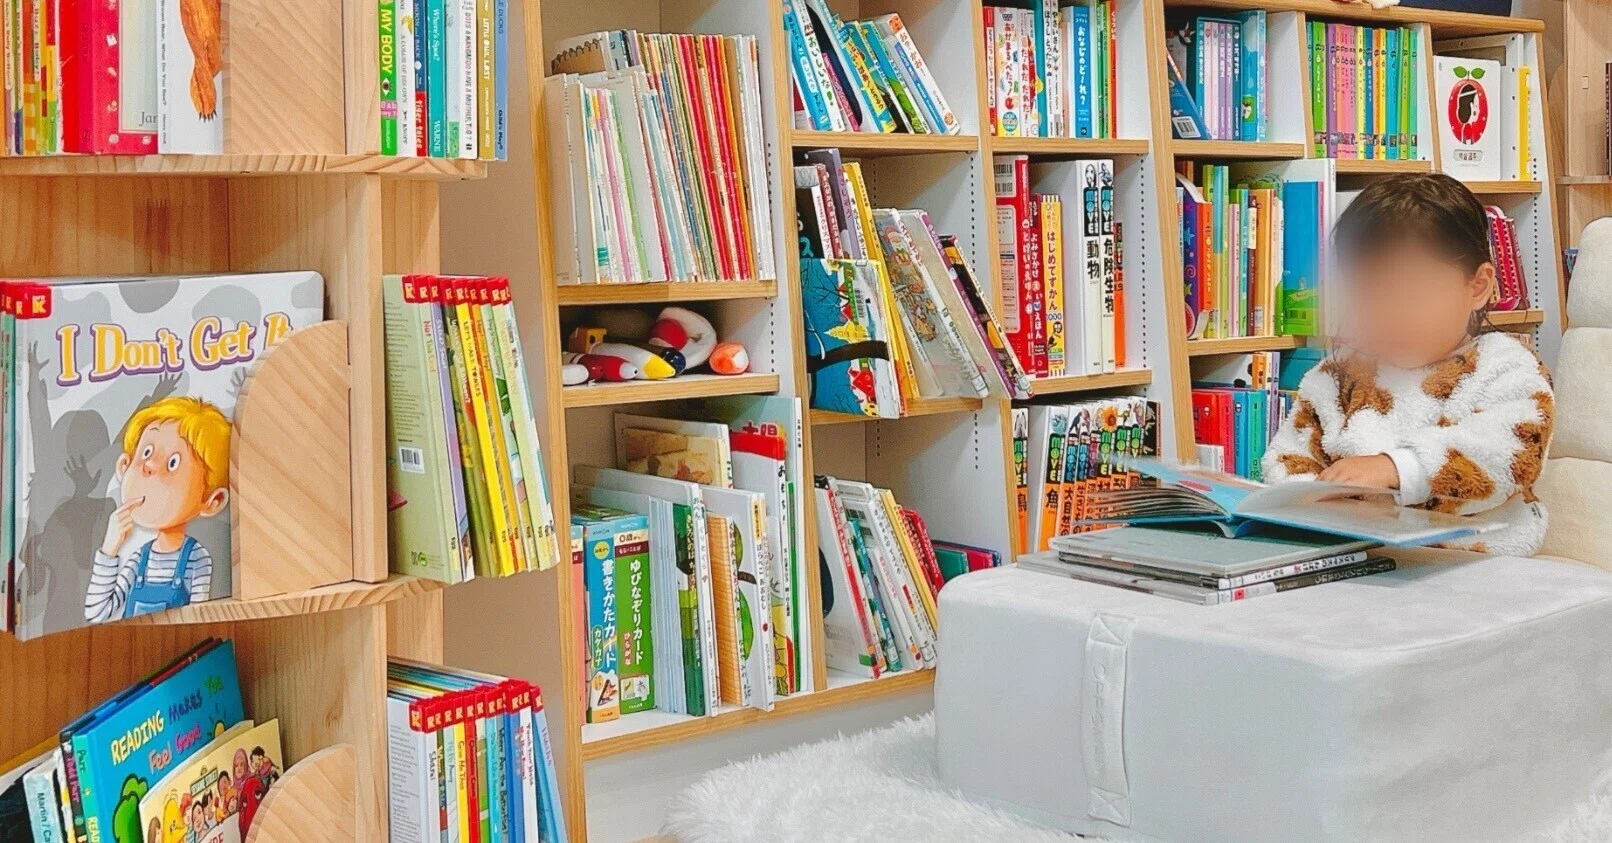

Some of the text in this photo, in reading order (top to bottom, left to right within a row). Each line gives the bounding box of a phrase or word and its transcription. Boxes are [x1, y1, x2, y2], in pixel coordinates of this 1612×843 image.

[381, 9, 393, 74] MY BODY
[432, 9, 441, 61] Where's Spot?
[433, 120, 441, 152] WARNE
[1046, 231, 1058, 311] はじめてずかん
[1087, 240, 1099, 279] 動物
[57, 324, 81, 386] I
[89, 322, 184, 382] Don't
[190, 316, 257, 370] Get
[1045, 488, 1059, 508] 魚
[602, 559, 617, 669] 書きかたカード
[629, 559, 644, 666] ゆびなぞりカード
[594, 628, 604, 667] カタカナ
[623, 631, 632, 666] ひらがな
[110, 709, 165, 766] READING
[148, 722, 202, 776] Feel Good
[37, 793, 48, 823] Martin
